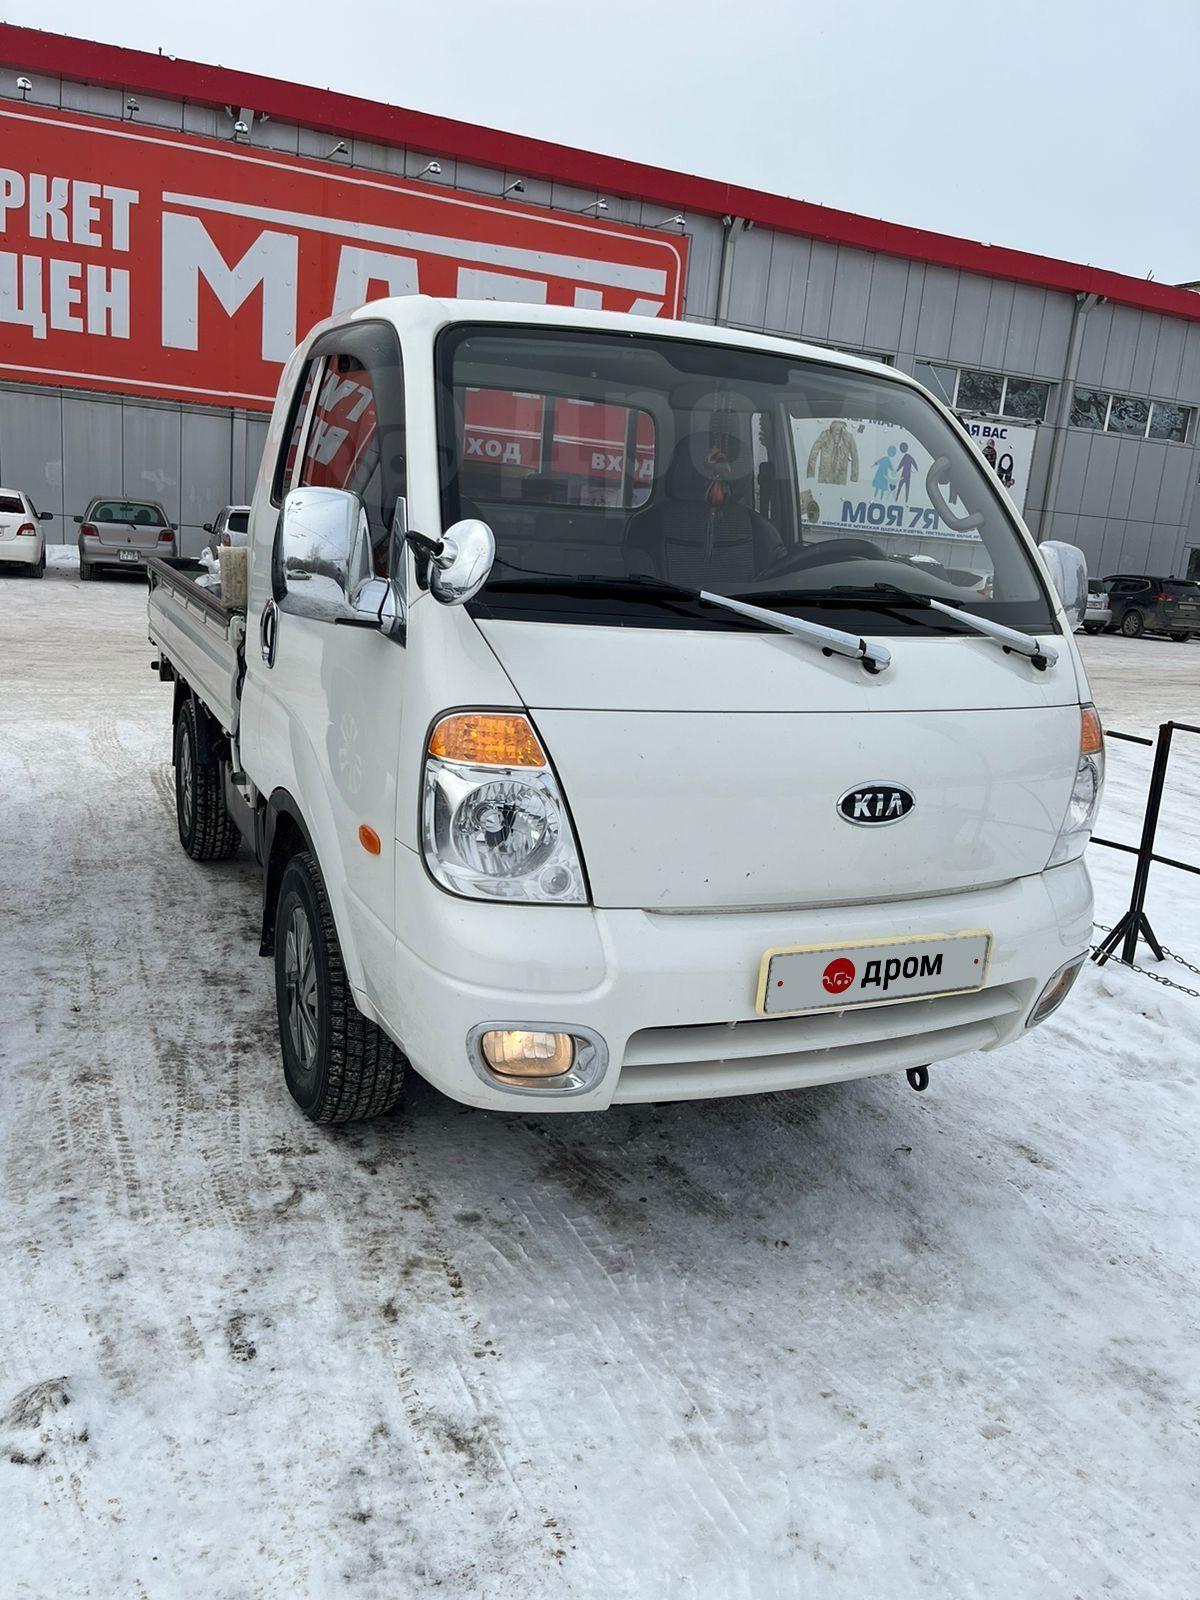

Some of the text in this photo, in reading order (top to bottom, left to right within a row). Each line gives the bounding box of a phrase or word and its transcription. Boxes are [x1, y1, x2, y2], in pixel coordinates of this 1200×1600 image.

[0, 167, 139, 252] РКЕТ
[983, 425, 1008, 440] ВАС
[466, 436, 522, 465] ХОД
[591, 452, 655, 479] ВХД
[841, 500, 940, 530] МОЯ 7Я
[853, 792, 903, 817] KIA
